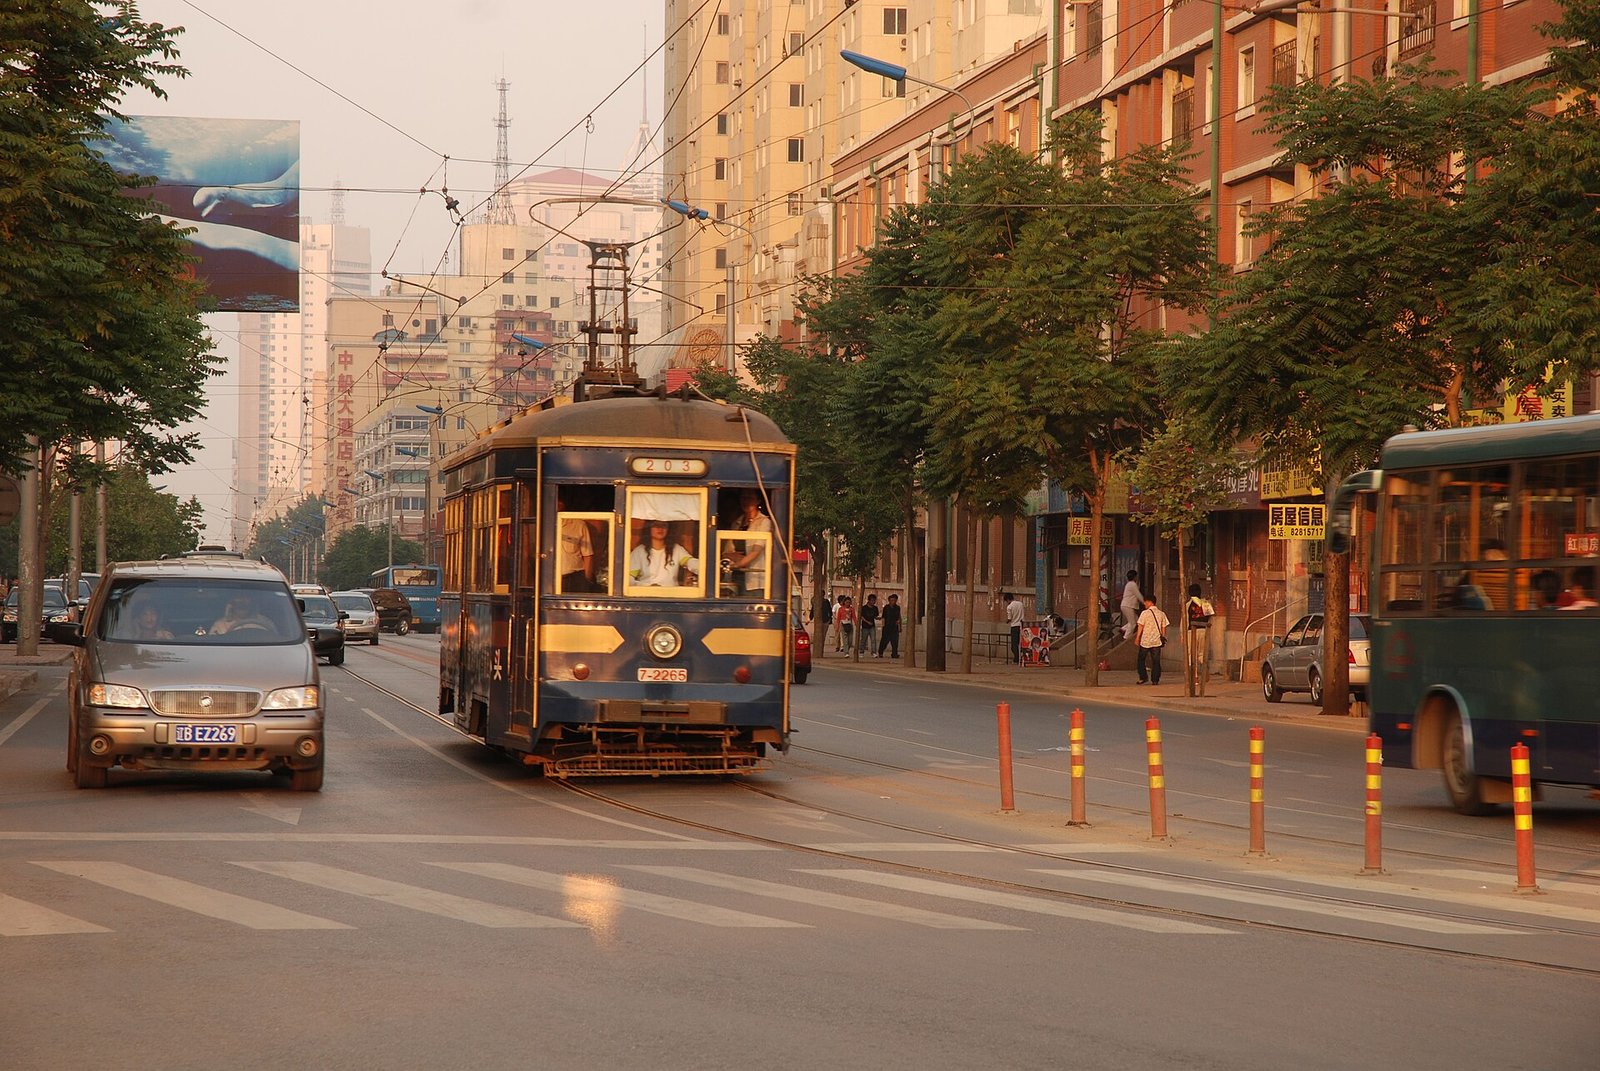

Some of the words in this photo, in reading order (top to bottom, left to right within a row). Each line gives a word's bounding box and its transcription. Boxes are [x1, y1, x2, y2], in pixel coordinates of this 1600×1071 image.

[646, 459, 690, 471] 203
[1271, 506, 1323, 526] 房屋信息
[1072, 519, 1113, 536] 房屋息
[1290, 527, 1323, 536] 82815717
[640, 669, 687, 681] 7-2265
[195, 726, 236, 742] EZ269
